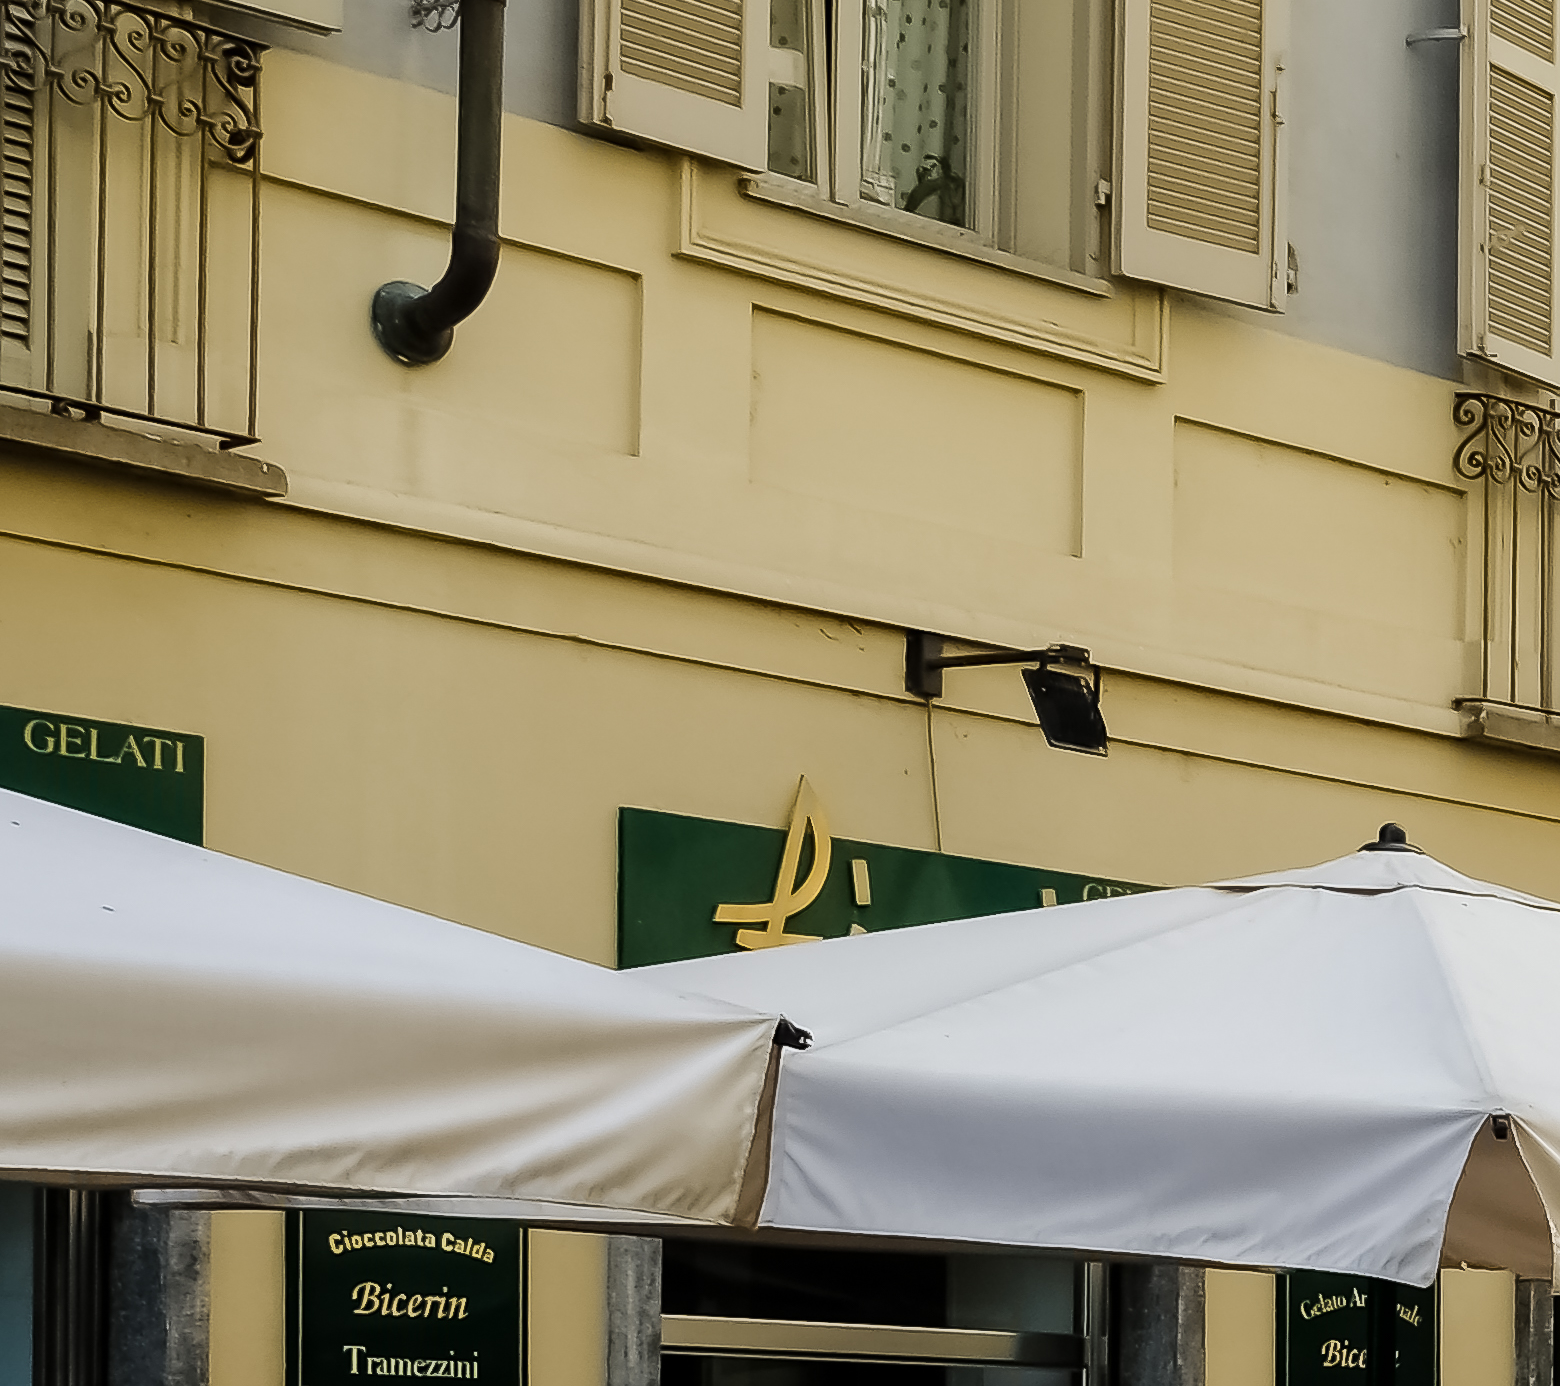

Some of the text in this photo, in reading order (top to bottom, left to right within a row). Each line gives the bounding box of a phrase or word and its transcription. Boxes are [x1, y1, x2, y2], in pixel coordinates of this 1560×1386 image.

[24, 719, 186, 773] GELATI
[328, 1226, 495, 1264] Cioccolata Calda
[351, 1281, 470, 1320] Bicerin
[1300, 1291, 1347, 1320] Gelato
[342, 1345, 479, 1380] Tramezzini
